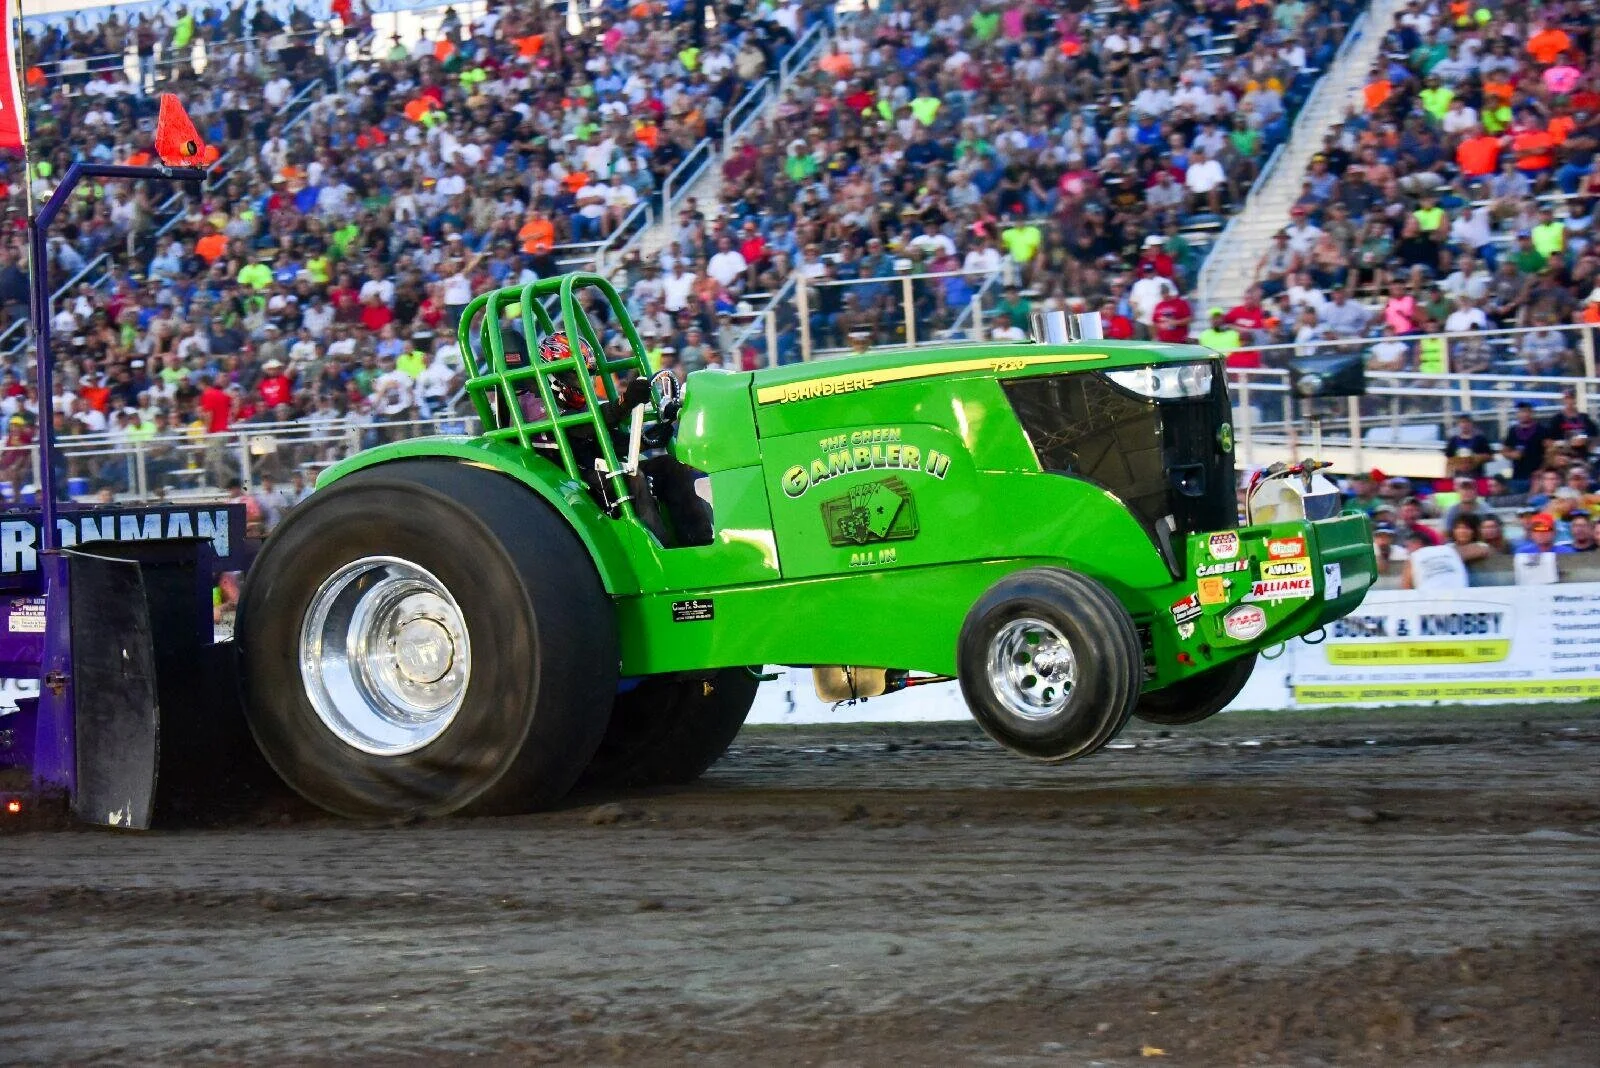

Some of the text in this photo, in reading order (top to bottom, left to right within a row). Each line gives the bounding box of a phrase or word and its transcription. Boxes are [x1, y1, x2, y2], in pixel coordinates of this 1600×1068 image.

[780, 377, 875, 404] JOHN DEERE
[819, 428, 902, 452] THE GREEN
[782, 444, 951, 498] GAMBLER II
[849, 548, 897, 567] ALL IN
[1196, 562, 1235, 577] CASE
[1268, 562, 1305, 575] AVIAID
[1253, 578, 1312, 597] ALLIANCE
